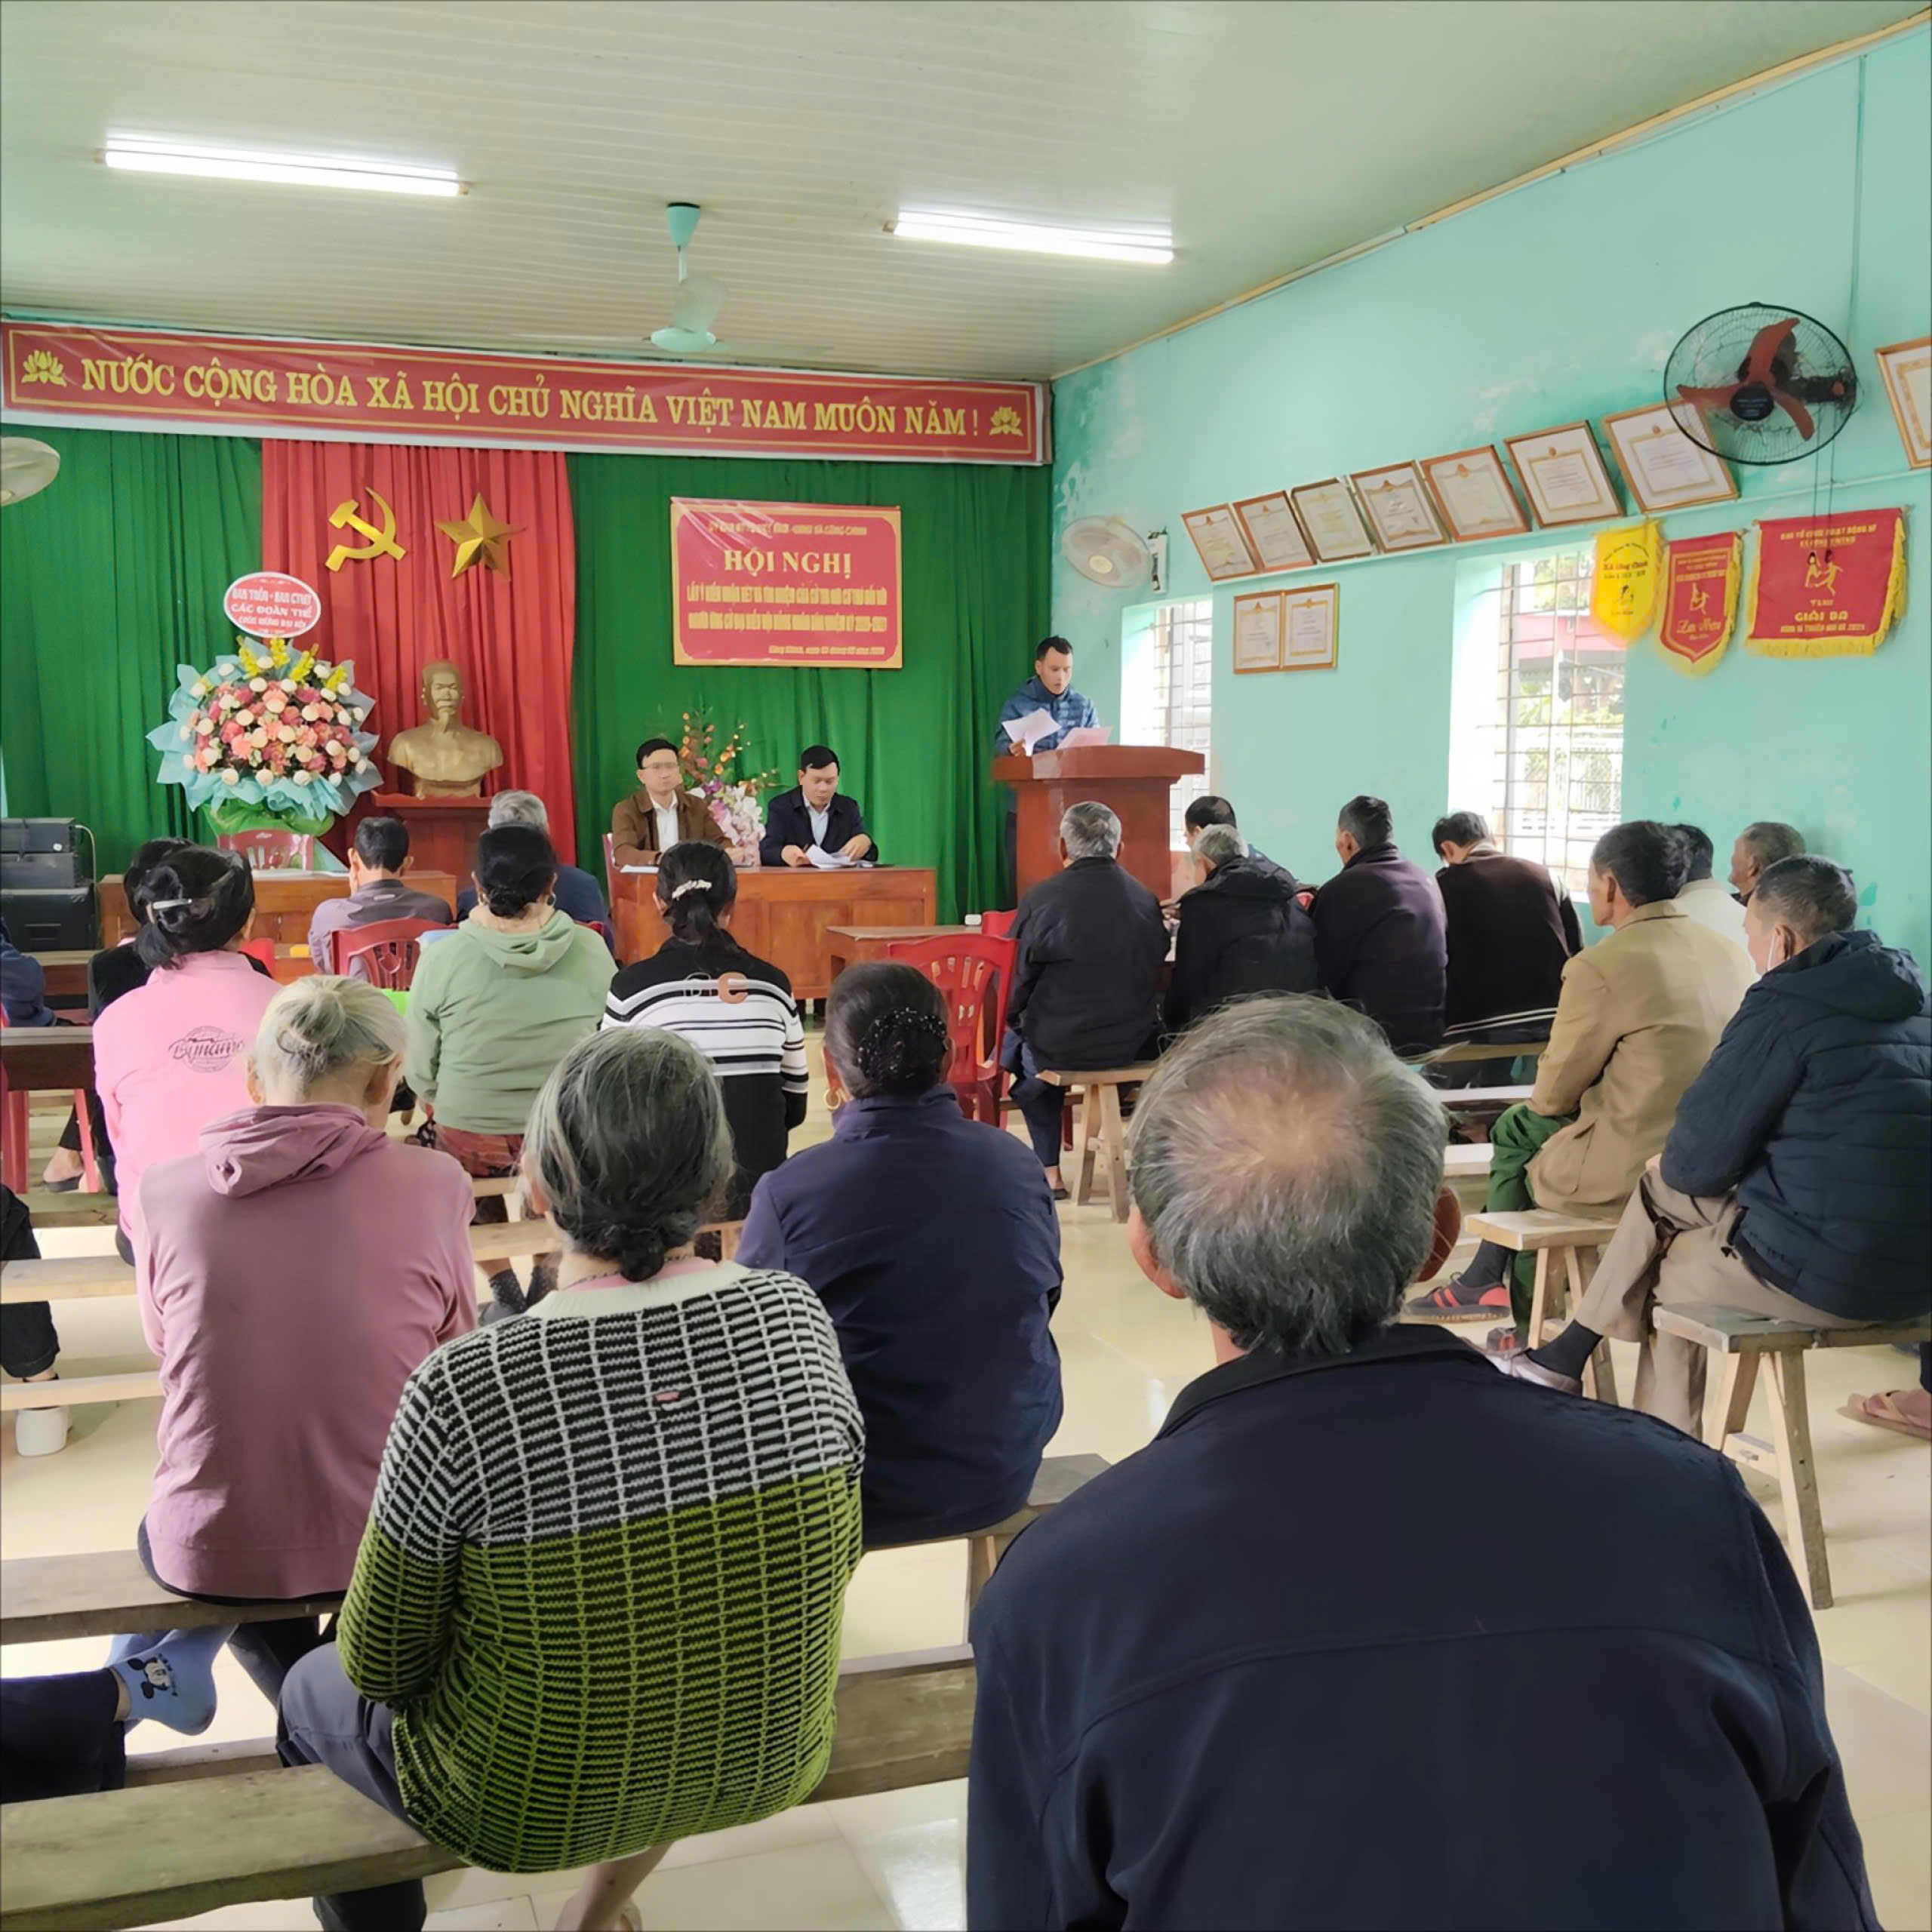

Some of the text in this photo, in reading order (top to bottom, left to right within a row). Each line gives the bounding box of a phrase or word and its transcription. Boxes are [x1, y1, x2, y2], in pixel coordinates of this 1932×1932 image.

[82, 352, 175, 396] NƯỚC
[183, 356, 278, 408] CỘNG
[286, 362, 358, 405] HÒA
[367, 371, 414, 409] XÃ
[422, 372, 480, 420] HỘI
[489, 374, 550, 420] CHỦ
[559, 385, 657, 423] NGHĨA
[666, 386, 734, 433] VIỆT
[741, 398, 806, 429] NAM
[814, 395, 896, 432] MUÔN
[724, 546, 851, 580] HỘI NGHỊ
